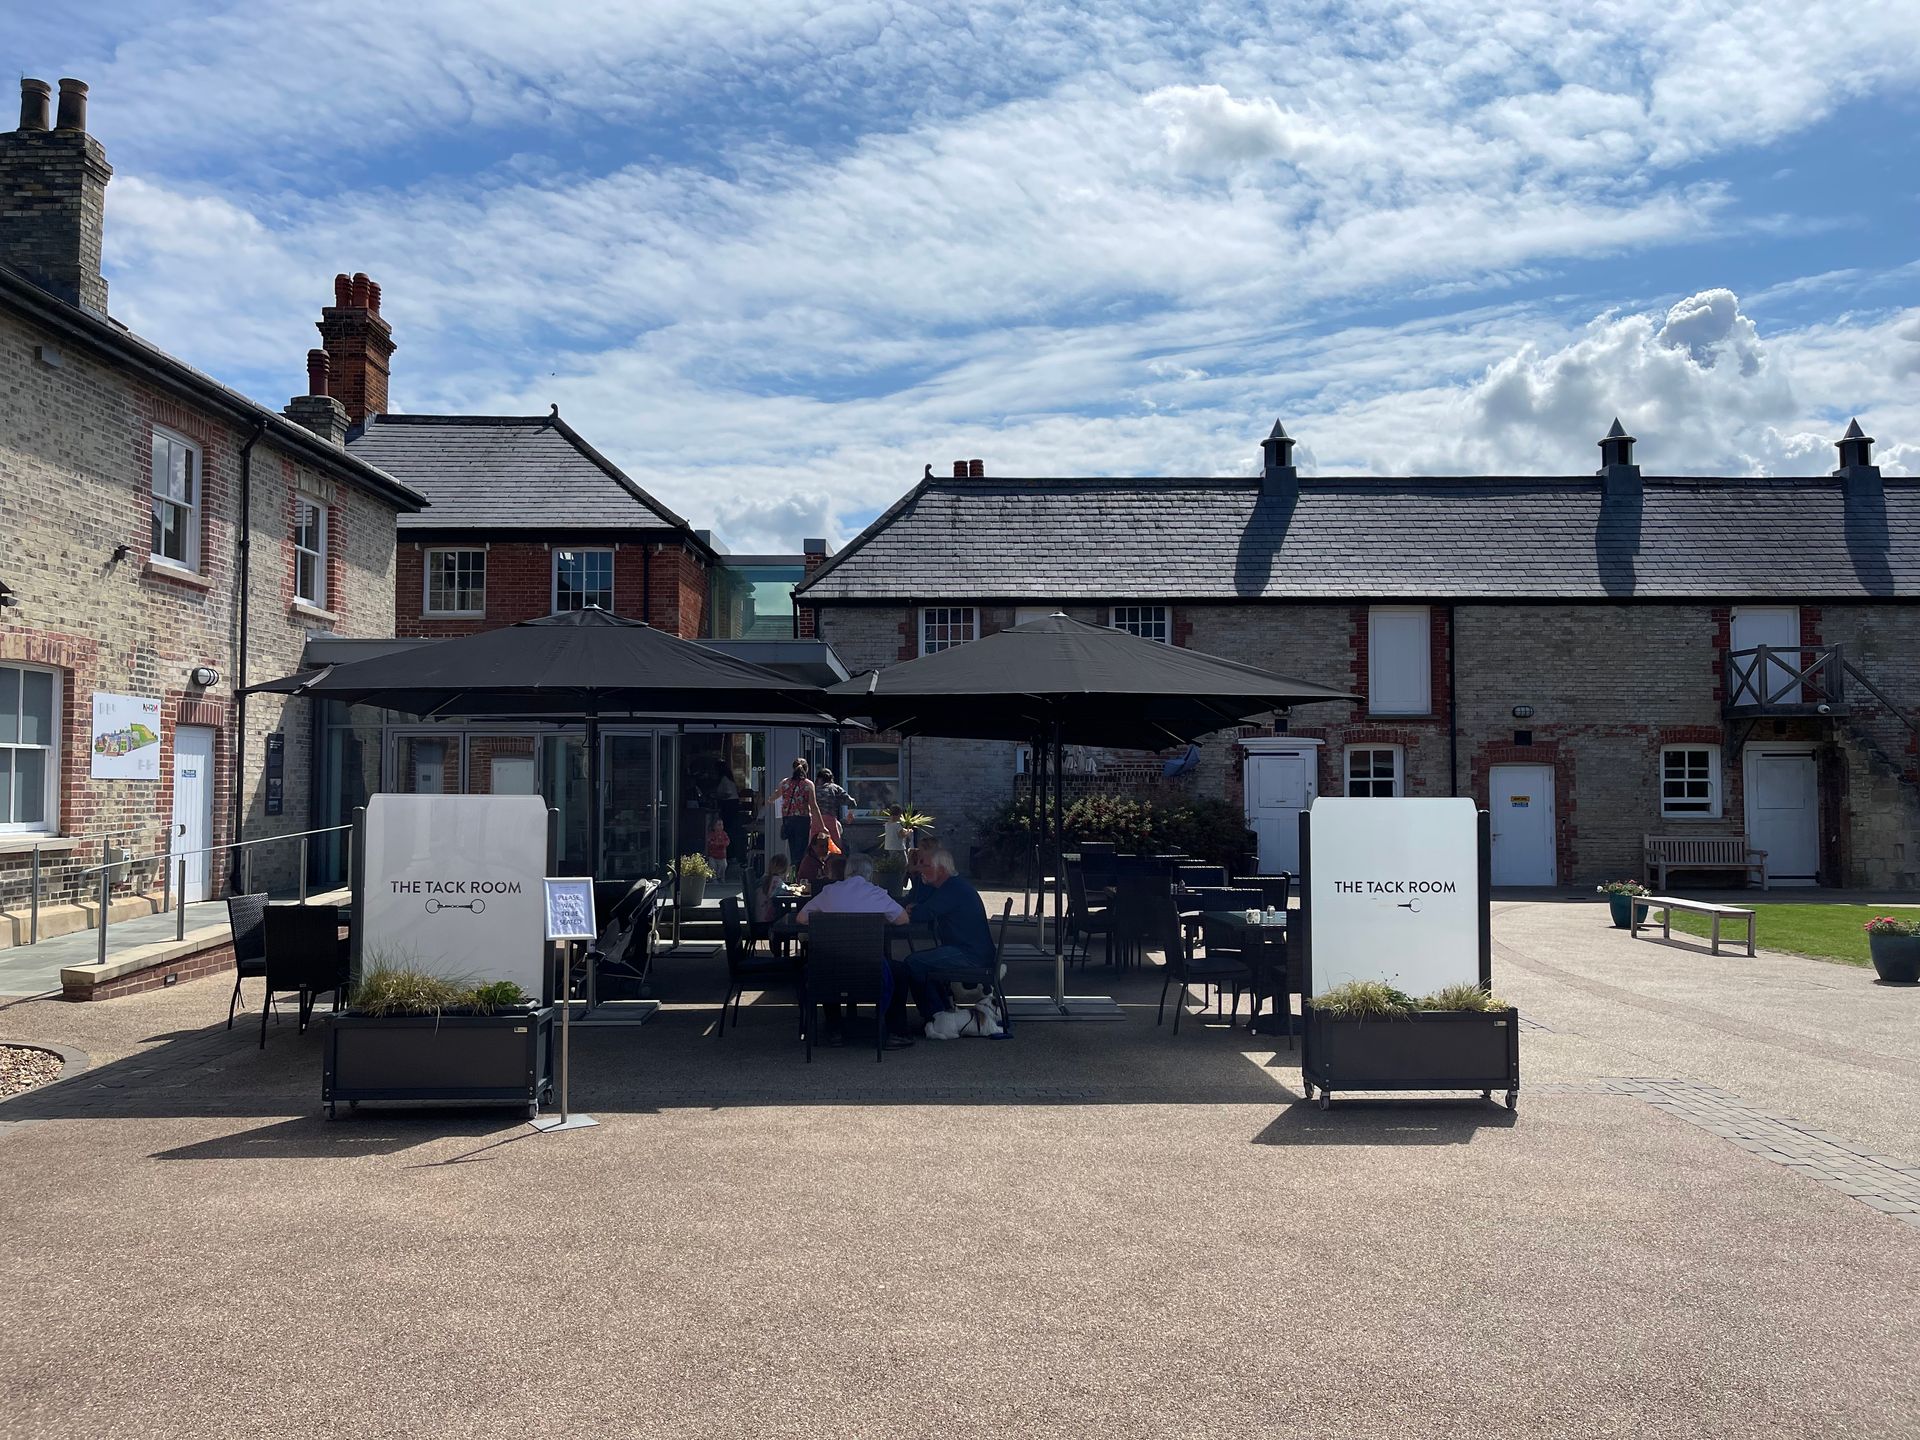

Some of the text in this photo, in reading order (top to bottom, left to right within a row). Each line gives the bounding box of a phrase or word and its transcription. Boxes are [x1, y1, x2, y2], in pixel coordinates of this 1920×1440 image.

[391, 881, 522, 893] THE TACK ROOM
[1334, 881, 1456, 893] THE TACK ROOM
